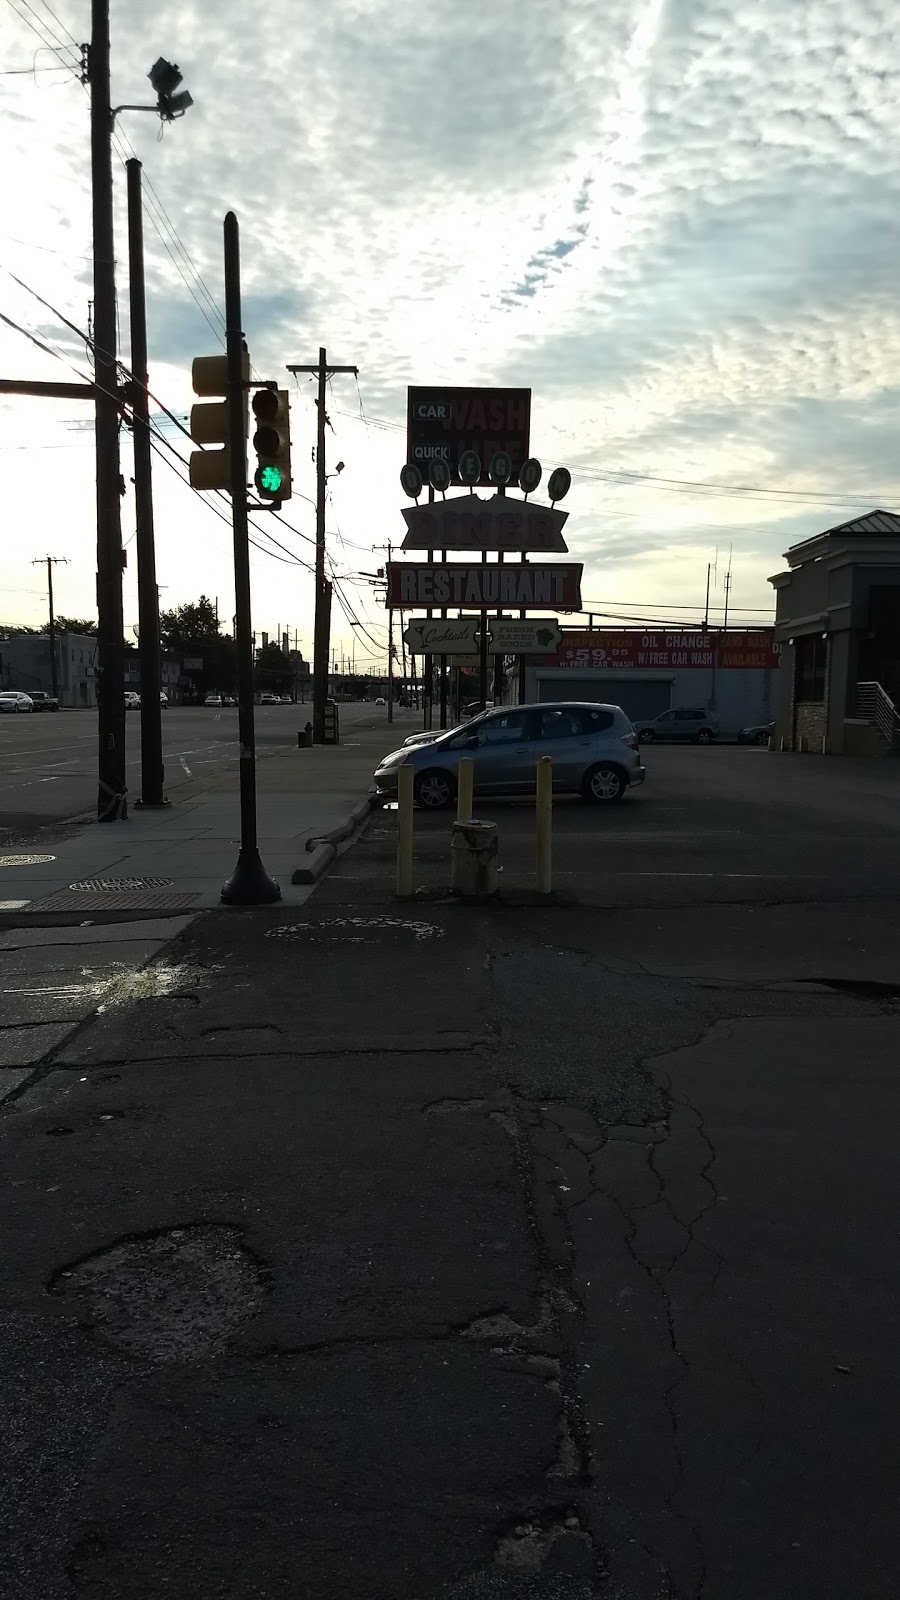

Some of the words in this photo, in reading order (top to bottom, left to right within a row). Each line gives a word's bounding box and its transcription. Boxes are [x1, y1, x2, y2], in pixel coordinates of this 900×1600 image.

[417, 405, 446, 418] CAR
[442, 399, 526, 432] WASH
[414, 446, 449, 459] QUICK
[405, 458, 567, 491] OREGON
[411, 511, 555, 546] DINER
[400, 570, 568, 602] RESTAURANT
[425, 626, 470, 643] Cocktails
[562, 638, 633, 648] INSPECTION
[641, 635, 659, 648] OIL
[665, 635, 711, 648] CHANGE
[720, 636, 743, 648] HAND
[748, 636, 771, 648] WASH
[566, 648, 629, 661] $59.95
[671, 652, 688, 665] CAR
[691, 652, 713, 665] WASH
[723, 653, 767, 666] AVAILABLE
